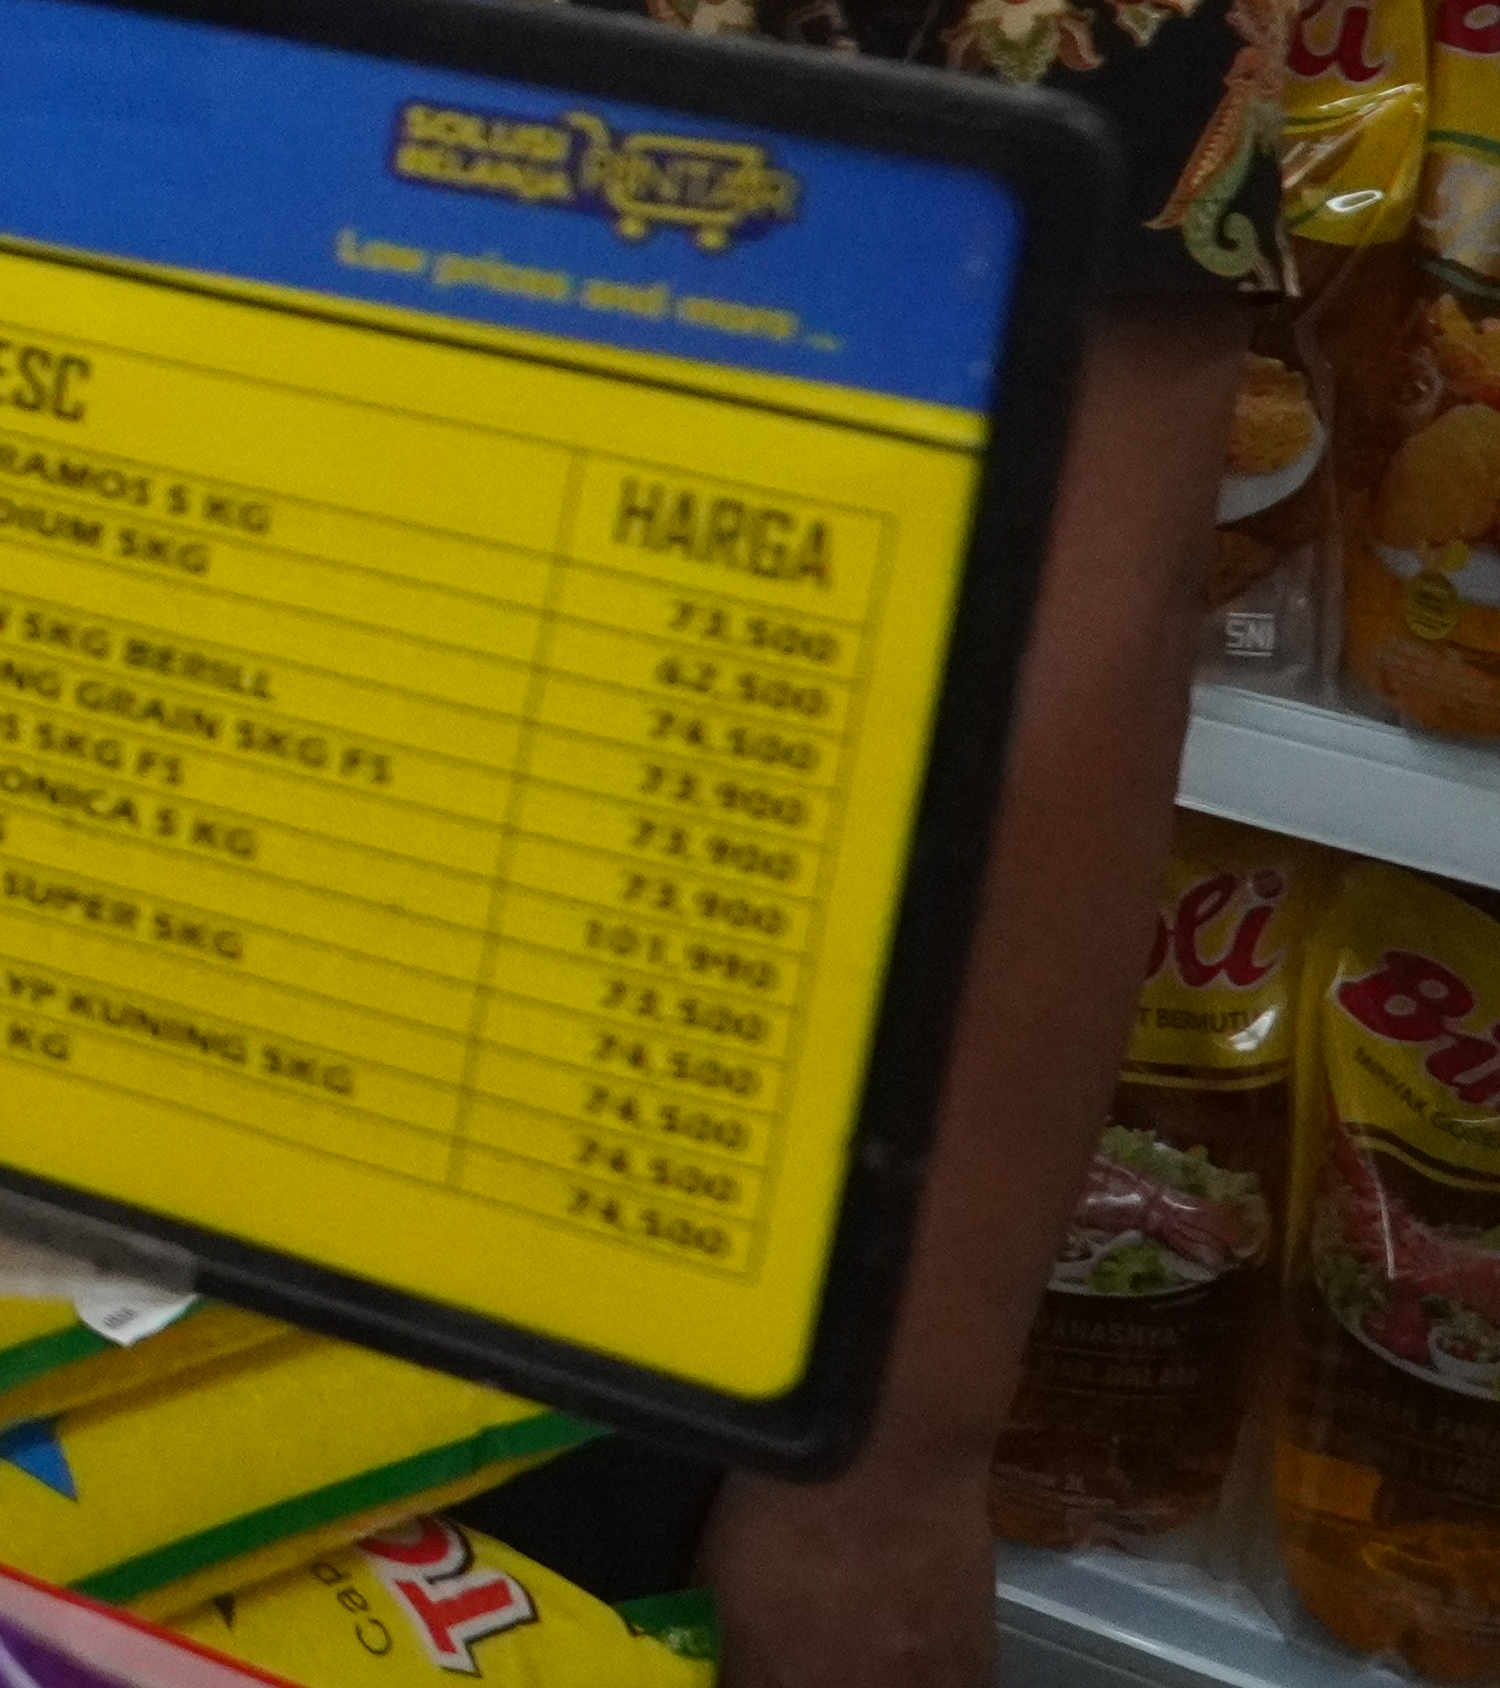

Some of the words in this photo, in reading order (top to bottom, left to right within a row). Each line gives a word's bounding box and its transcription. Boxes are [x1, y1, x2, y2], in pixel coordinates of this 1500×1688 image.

[337, 228, 424, 274] Low
[579, 274, 670, 315] and
[610, 475, 836, 590] HARGA
[1223, 616, 1278, 654] SNI
[75, 680, 220, 741] GRAIN
[2, 870, 140, 929] SUPER
[306, 1554, 396, 1662] Cap
